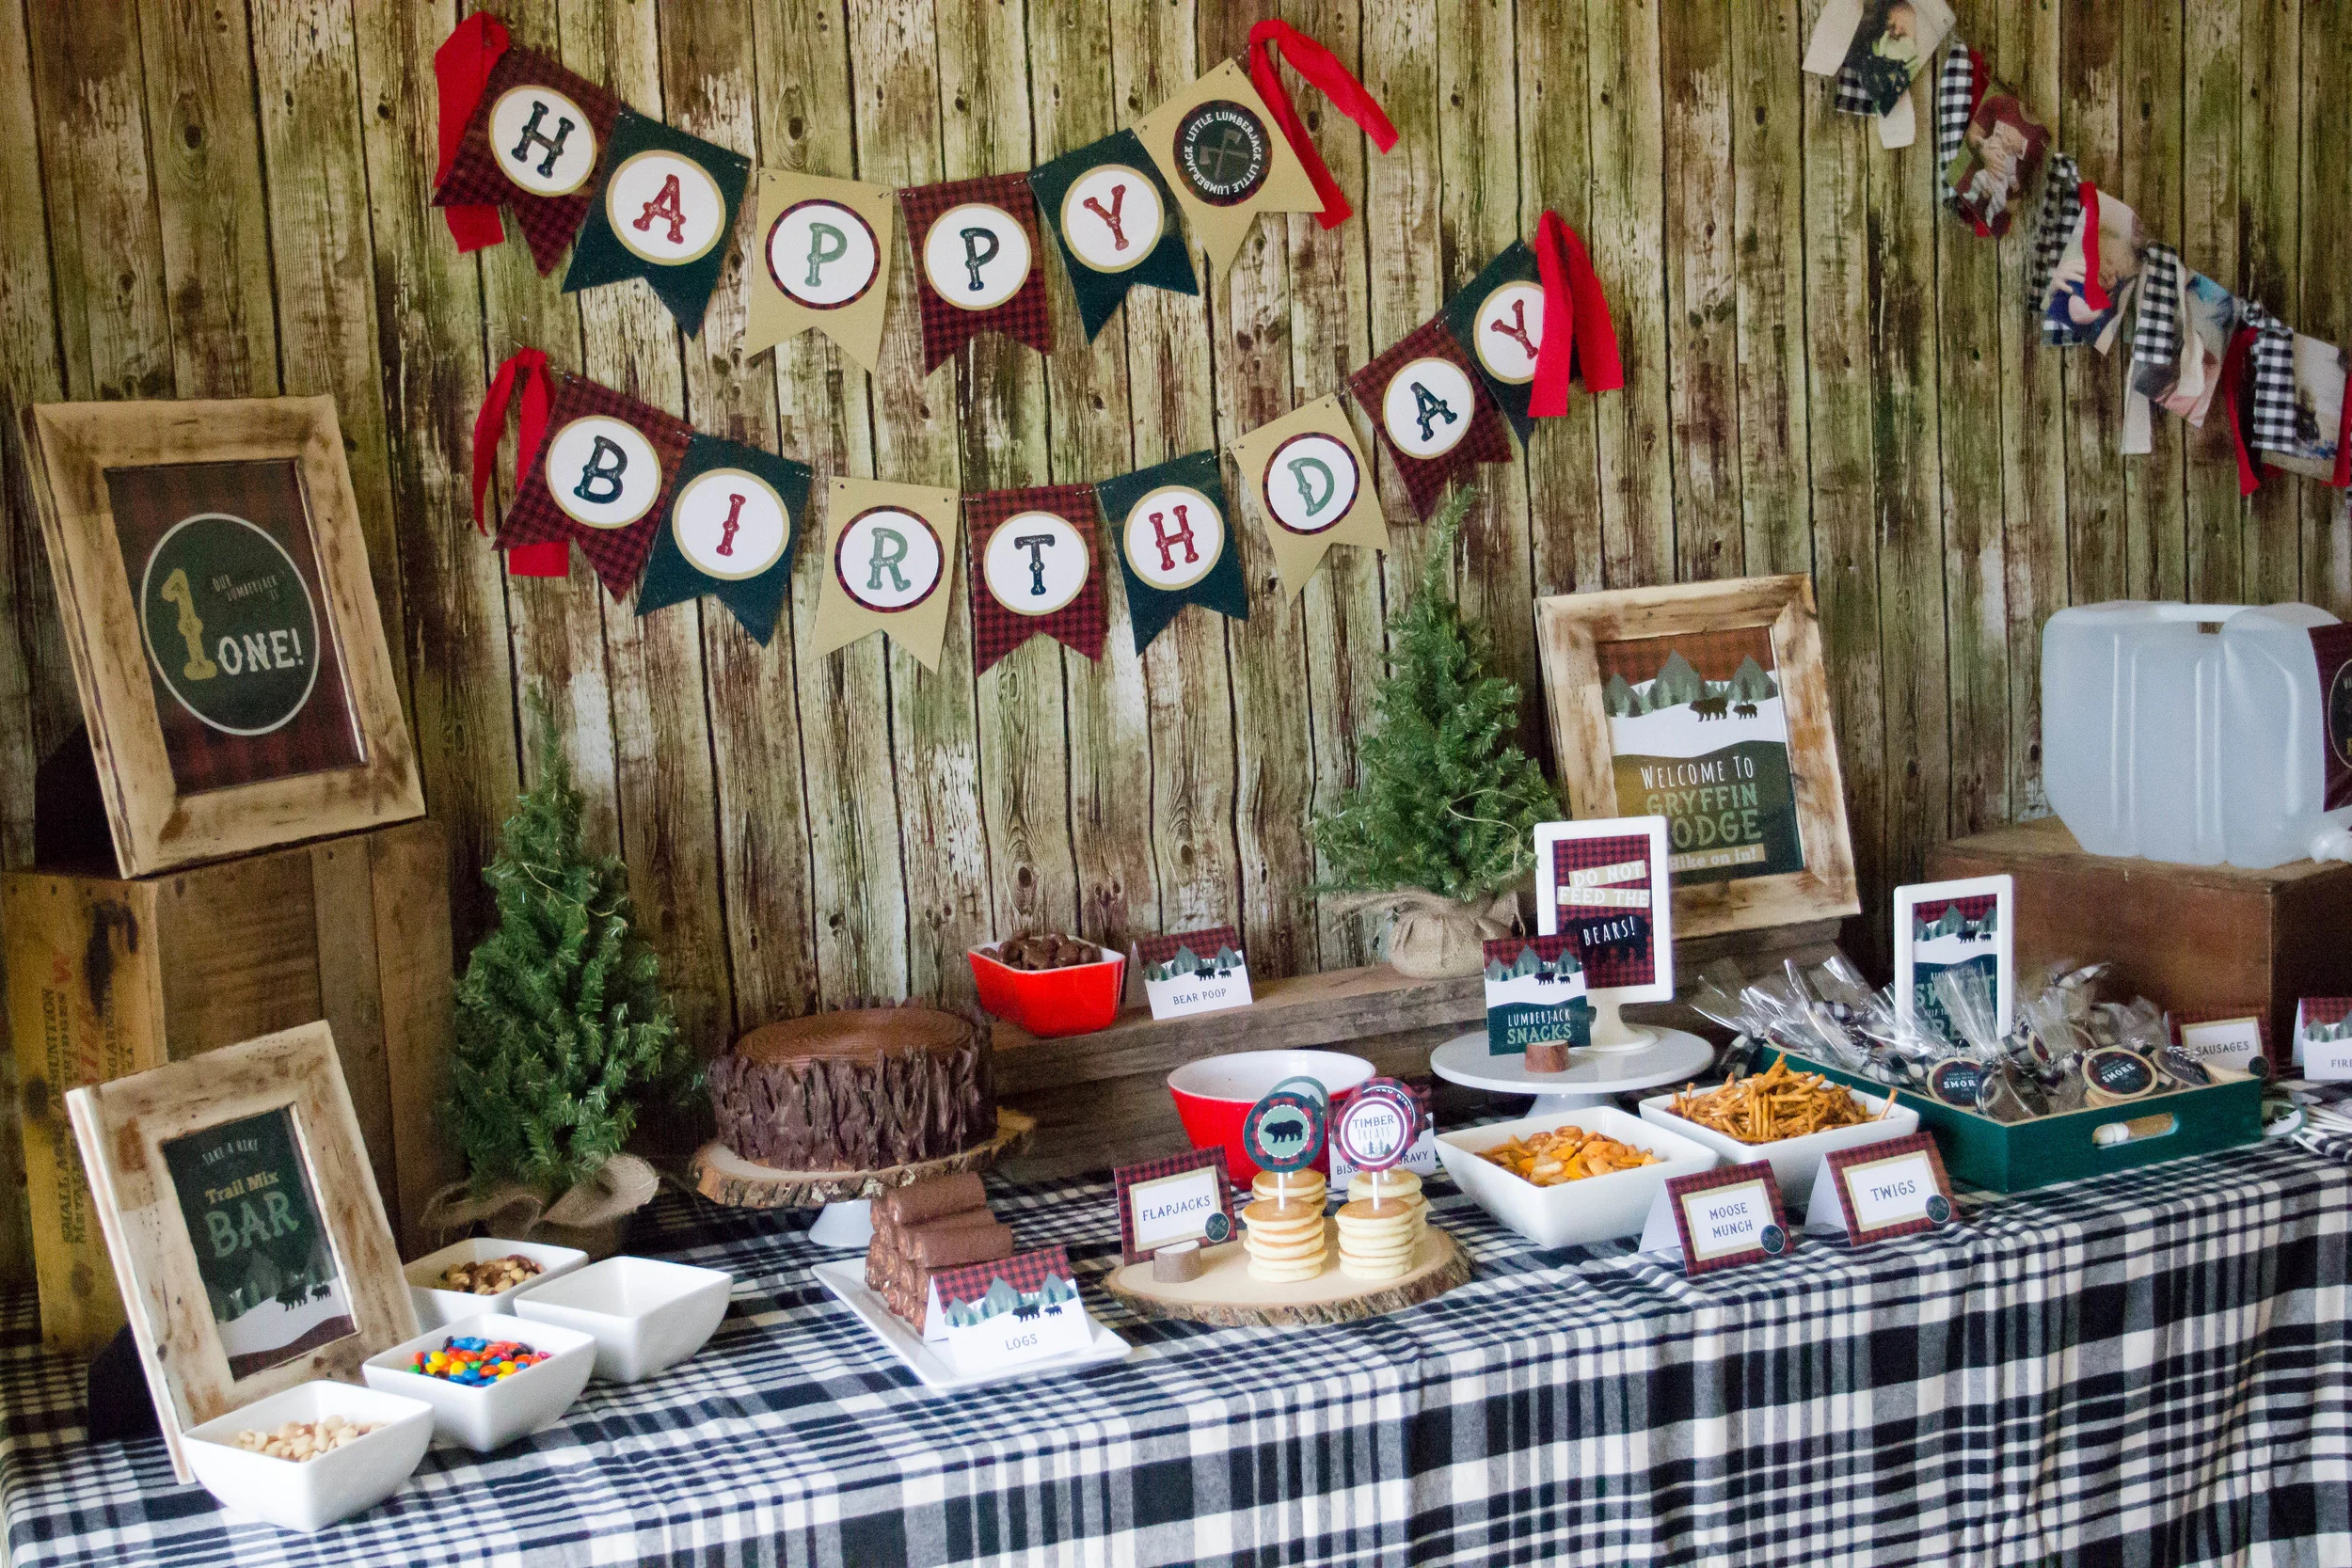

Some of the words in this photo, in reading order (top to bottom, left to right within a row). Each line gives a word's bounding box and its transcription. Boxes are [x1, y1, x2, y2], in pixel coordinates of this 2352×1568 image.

[1186, 112, 1214, 142] LITTLE
[1216, 111, 1263, 161] LUMBERJACK
[1184, 145, 1230, 196] LUMBERJACK
[1232, 164, 1260, 194] LITTLE
[162, 568, 217, 681] 1
[218, 627, 305, 675] ONE!
[1641, 759, 1725, 791] WELCOME
[1732, 755, 1755, 780] TO
[1645, 783, 1758, 817] GRYFFIN
[1669, 809, 1762, 847] ODGE
[1710, 852, 1731, 865] on
[1572, 870, 1598, 888] DO
[1606, 862, 1644, 882] NOT
[1558, 888, 1606, 904] FEED
[1613, 888, 1649, 906] THE
[1583, 915, 1637, 946] BEARS!
[1173, 991, 1200, 1006] BEAR
[1202, 988, 1228, 1001] POOP
[1507, 1008, 1571, 1027] LUMBERJACK
[1507, 1022, 1572, 1045] SNACKS
[2196, 1040, 2249, 1055] SAUSAGES
[1943, 1079, 1978, 1089] SMOR
[2102, 1063, 2136, 1083] SMORE
[1352, 1115, 1394, 1129] TIMBER
[1358, 1127, 1391, 1140] TREATS
[204, 1178, 246, 1204] Trail
[246, 1171, 279, 1192] Mix
[1870, 1180, 1916, 1202] TWIGS
[1142, 1195, 1211, 1222] FLAPJACKS
[1709, 1202, 1748, 1220] MOOSE
[204, 1191, 300, 1259] BAR
[1712, 1219, 1754, 1238] MUNCH
[1006, 1334, 1038, 1351] LOGS
